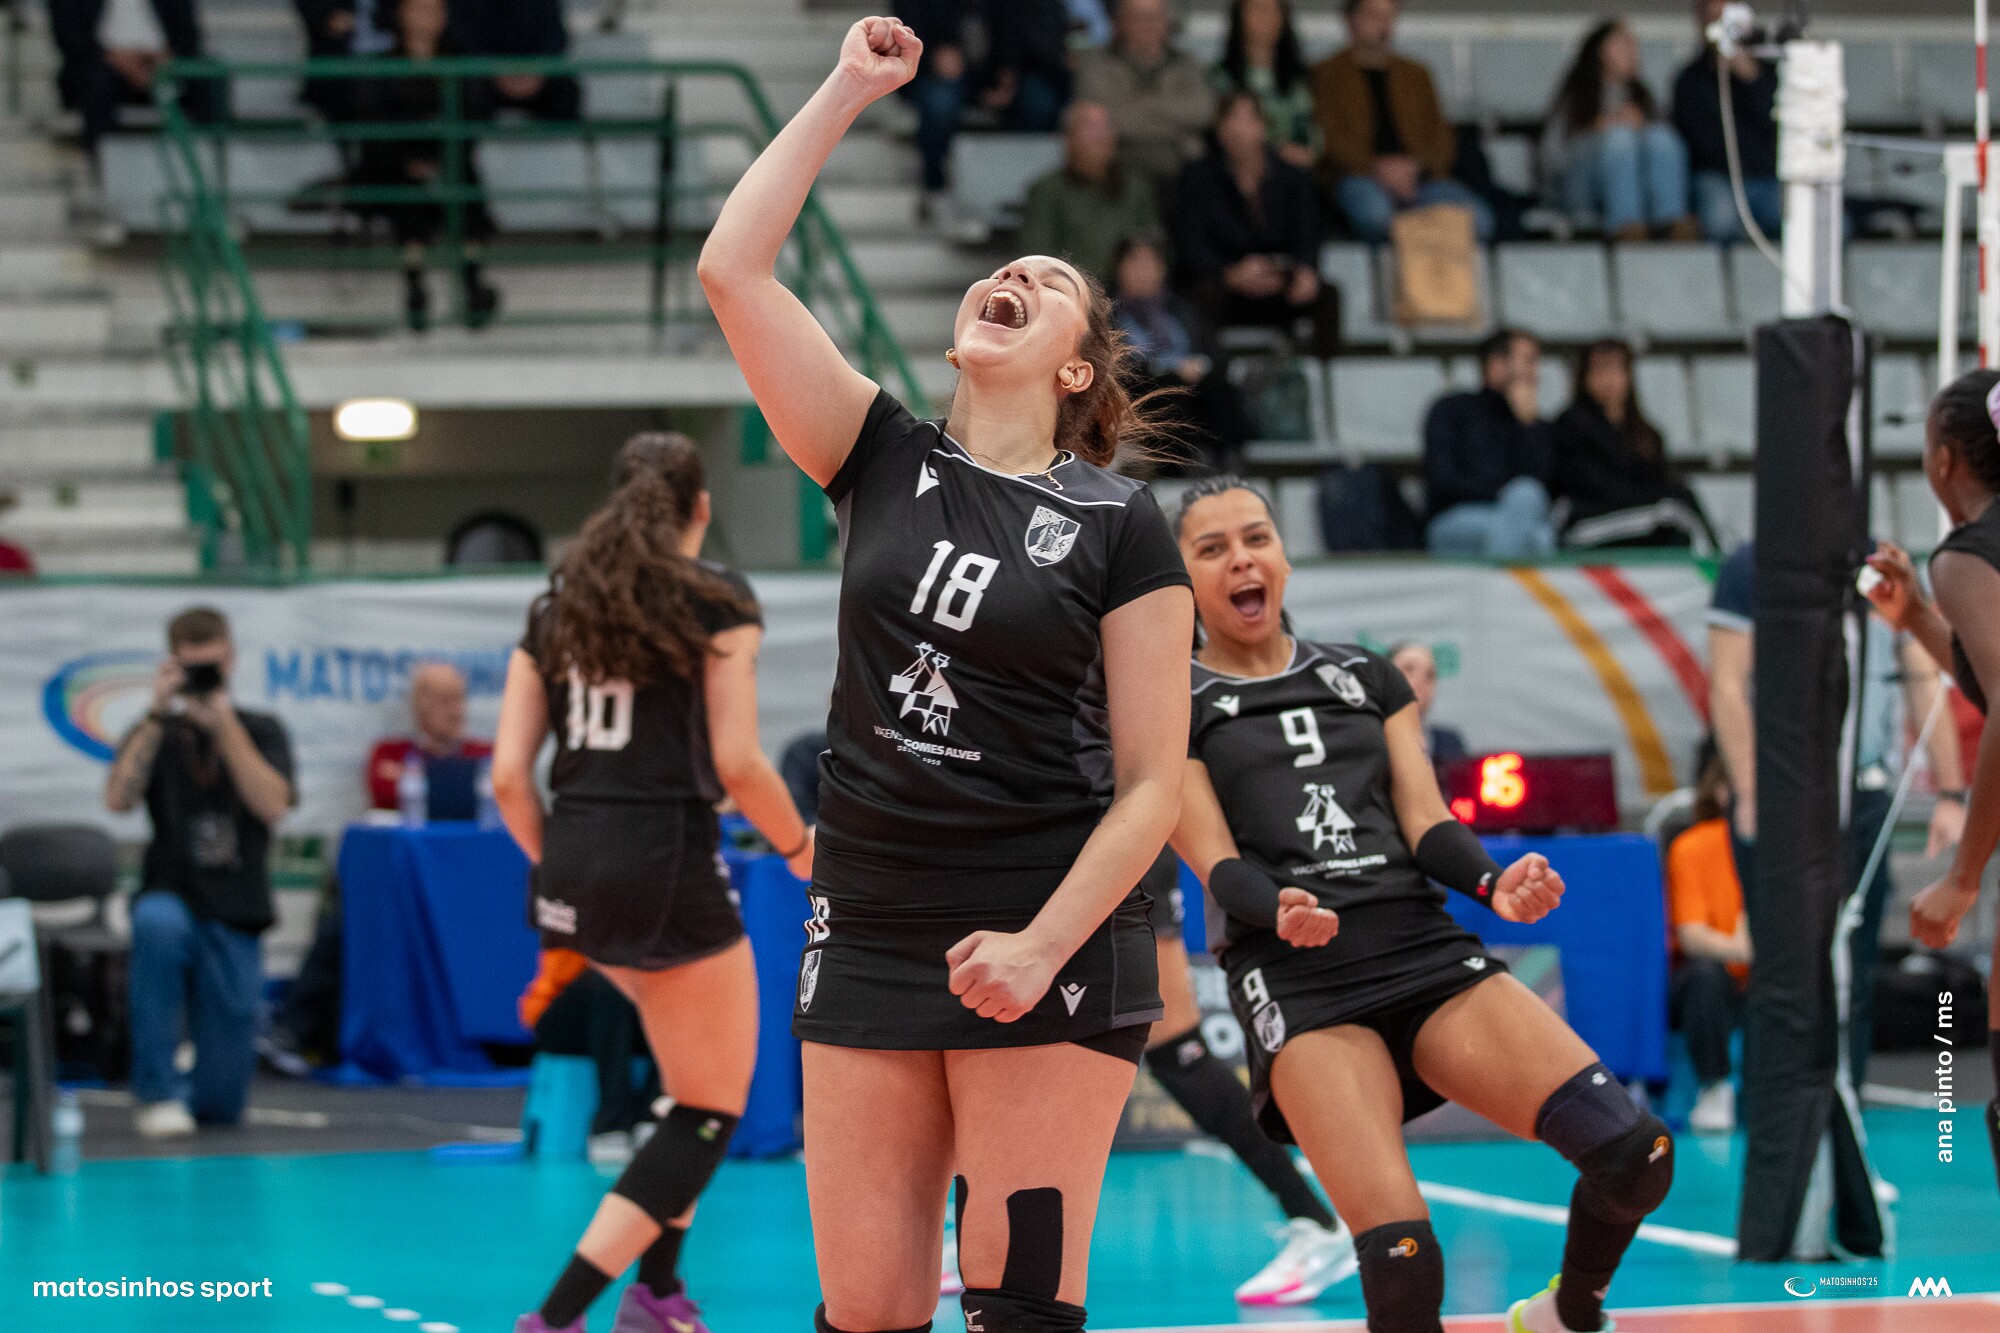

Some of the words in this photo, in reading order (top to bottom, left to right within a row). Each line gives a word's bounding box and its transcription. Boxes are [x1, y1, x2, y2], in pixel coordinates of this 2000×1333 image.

[909, 540, 1000, 632] 18
[566, 662, 635, 751] 10
[944, 746, 982, 762] ALVES
[1279, 706, 1326, 768] 9
[803, 895, 831, 944] 18
[1242, 967, 1271, 1015] 9
